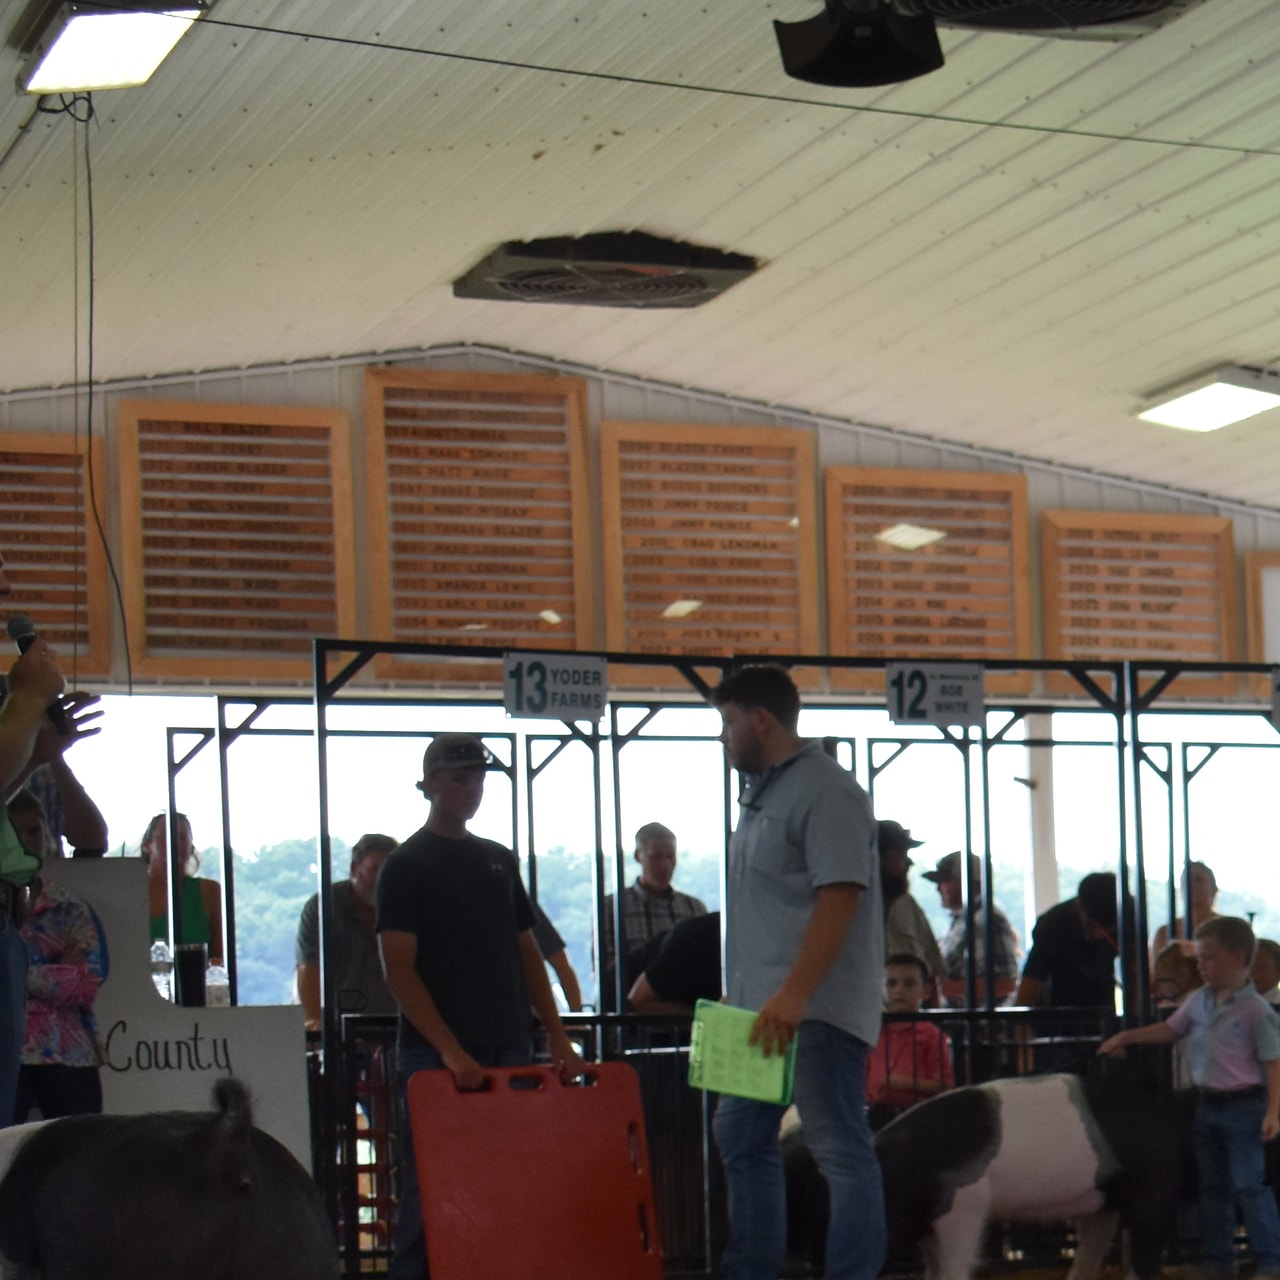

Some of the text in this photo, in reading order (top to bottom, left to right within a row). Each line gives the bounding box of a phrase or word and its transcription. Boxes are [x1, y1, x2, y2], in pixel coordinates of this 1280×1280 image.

[550, 668, 602, 685] YODER
[509, 661, 548, 713] 13
[890, 670, 927, 718] 12
[941, 685, 963, 697] BOB
[551, 692, 602, 709] FARMS
[934, 702, 969, 713] WHITE
[105, 1020, 233, 1076] County
